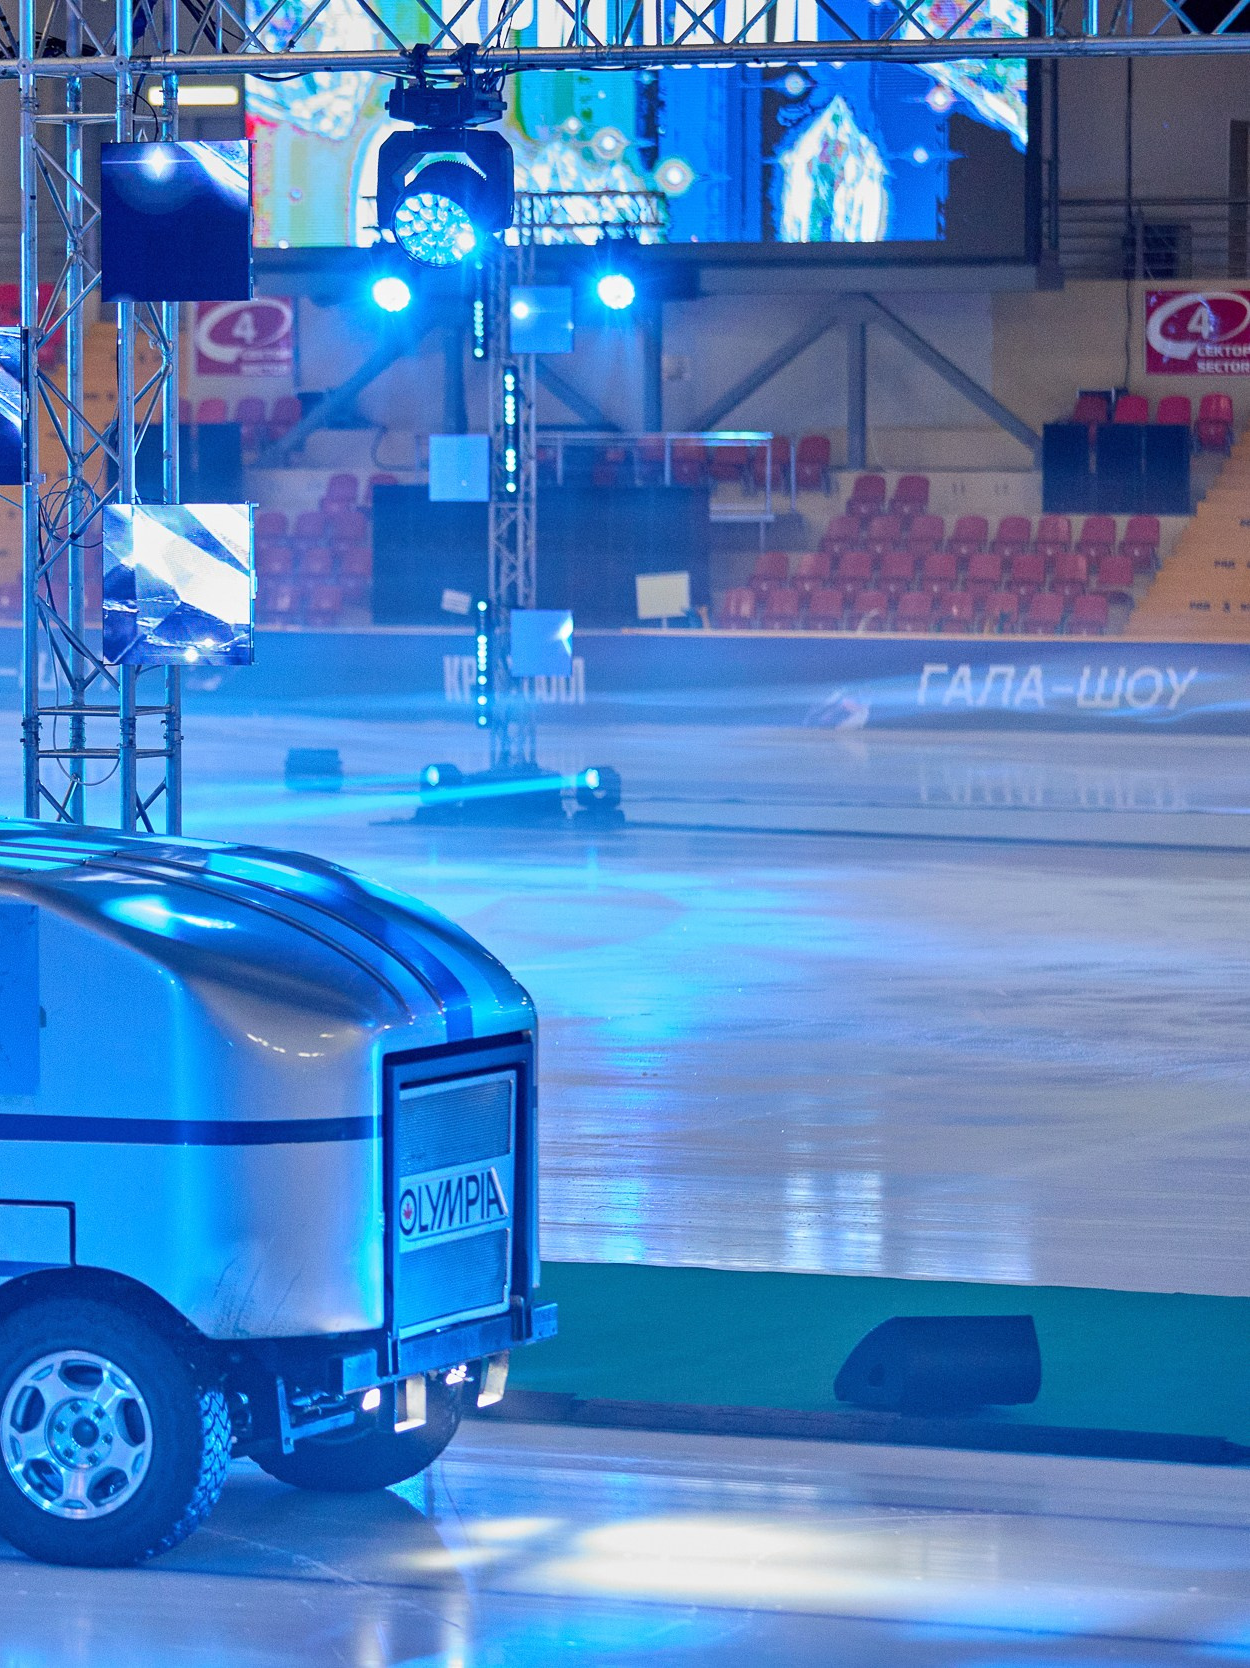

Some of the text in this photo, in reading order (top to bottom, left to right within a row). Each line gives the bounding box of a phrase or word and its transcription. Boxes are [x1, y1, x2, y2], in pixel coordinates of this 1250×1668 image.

[233, 311, 256, 345] 4
[1187, 304, 1211, 340] 4
[917, 663, 1199, 710] ГАЛА-ШОУ
[399, 1171, 504, 1236] OLYMPIA
